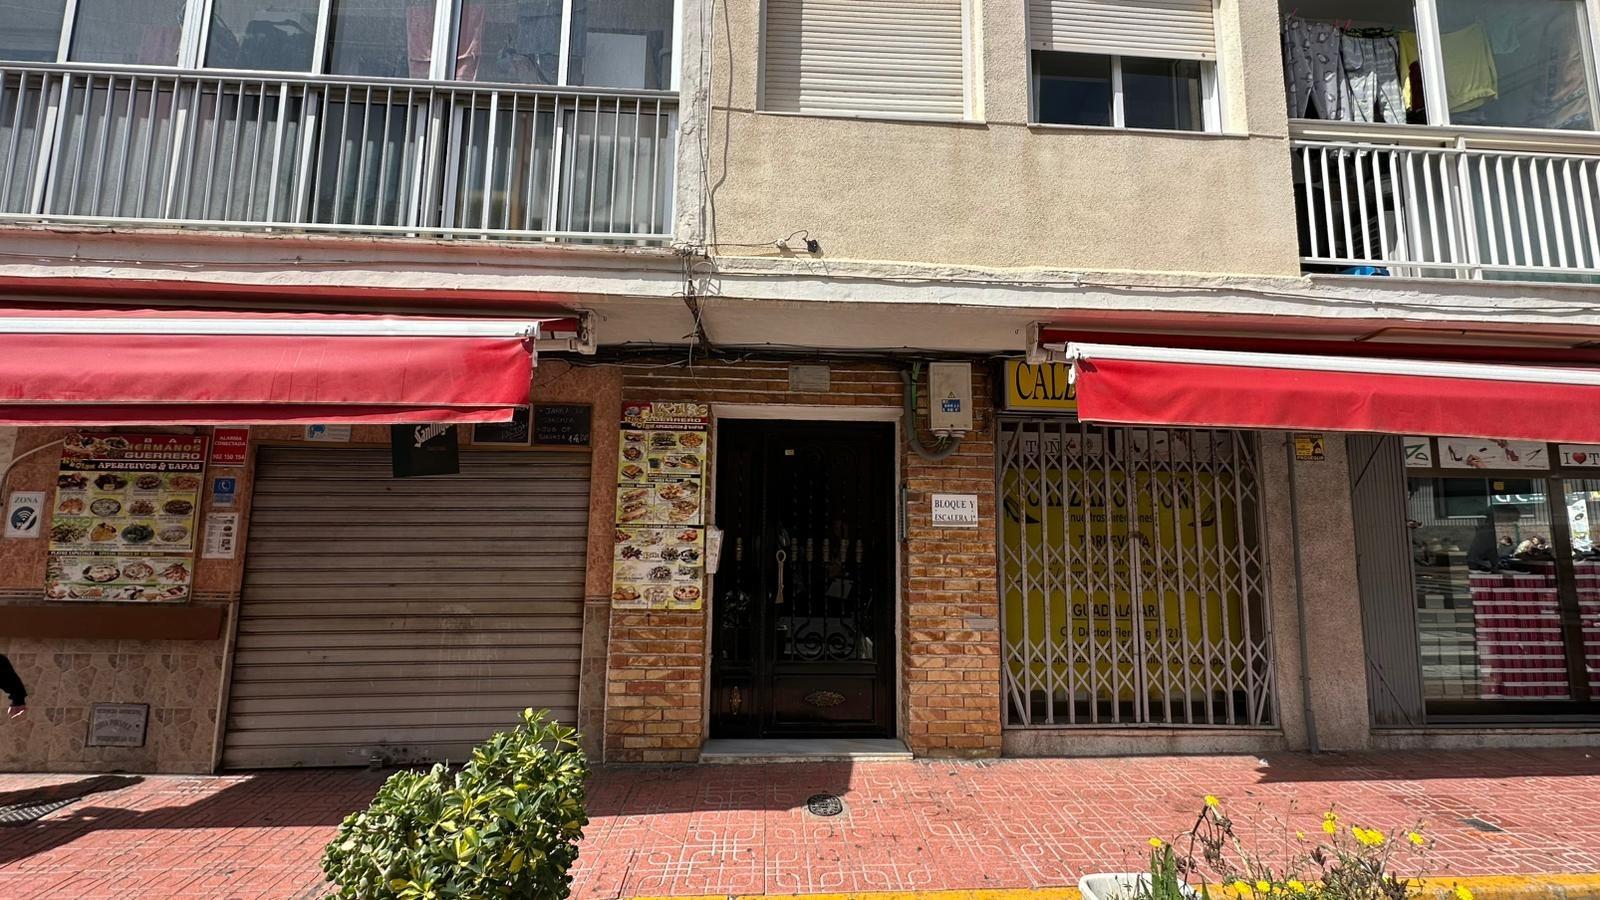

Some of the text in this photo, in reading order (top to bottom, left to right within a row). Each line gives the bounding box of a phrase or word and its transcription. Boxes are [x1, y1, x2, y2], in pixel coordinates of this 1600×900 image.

[126, 443, 201, 451] HERMANOS
[124, 451, 200, 460] GUERRERO
[98, 461, 157, 470] APERITIVOS
[168, 462, 200, 470] TAPAS
[934, 500, 967, 510] BLOQUE
[1079, 627, 1110, 636] Dtor
